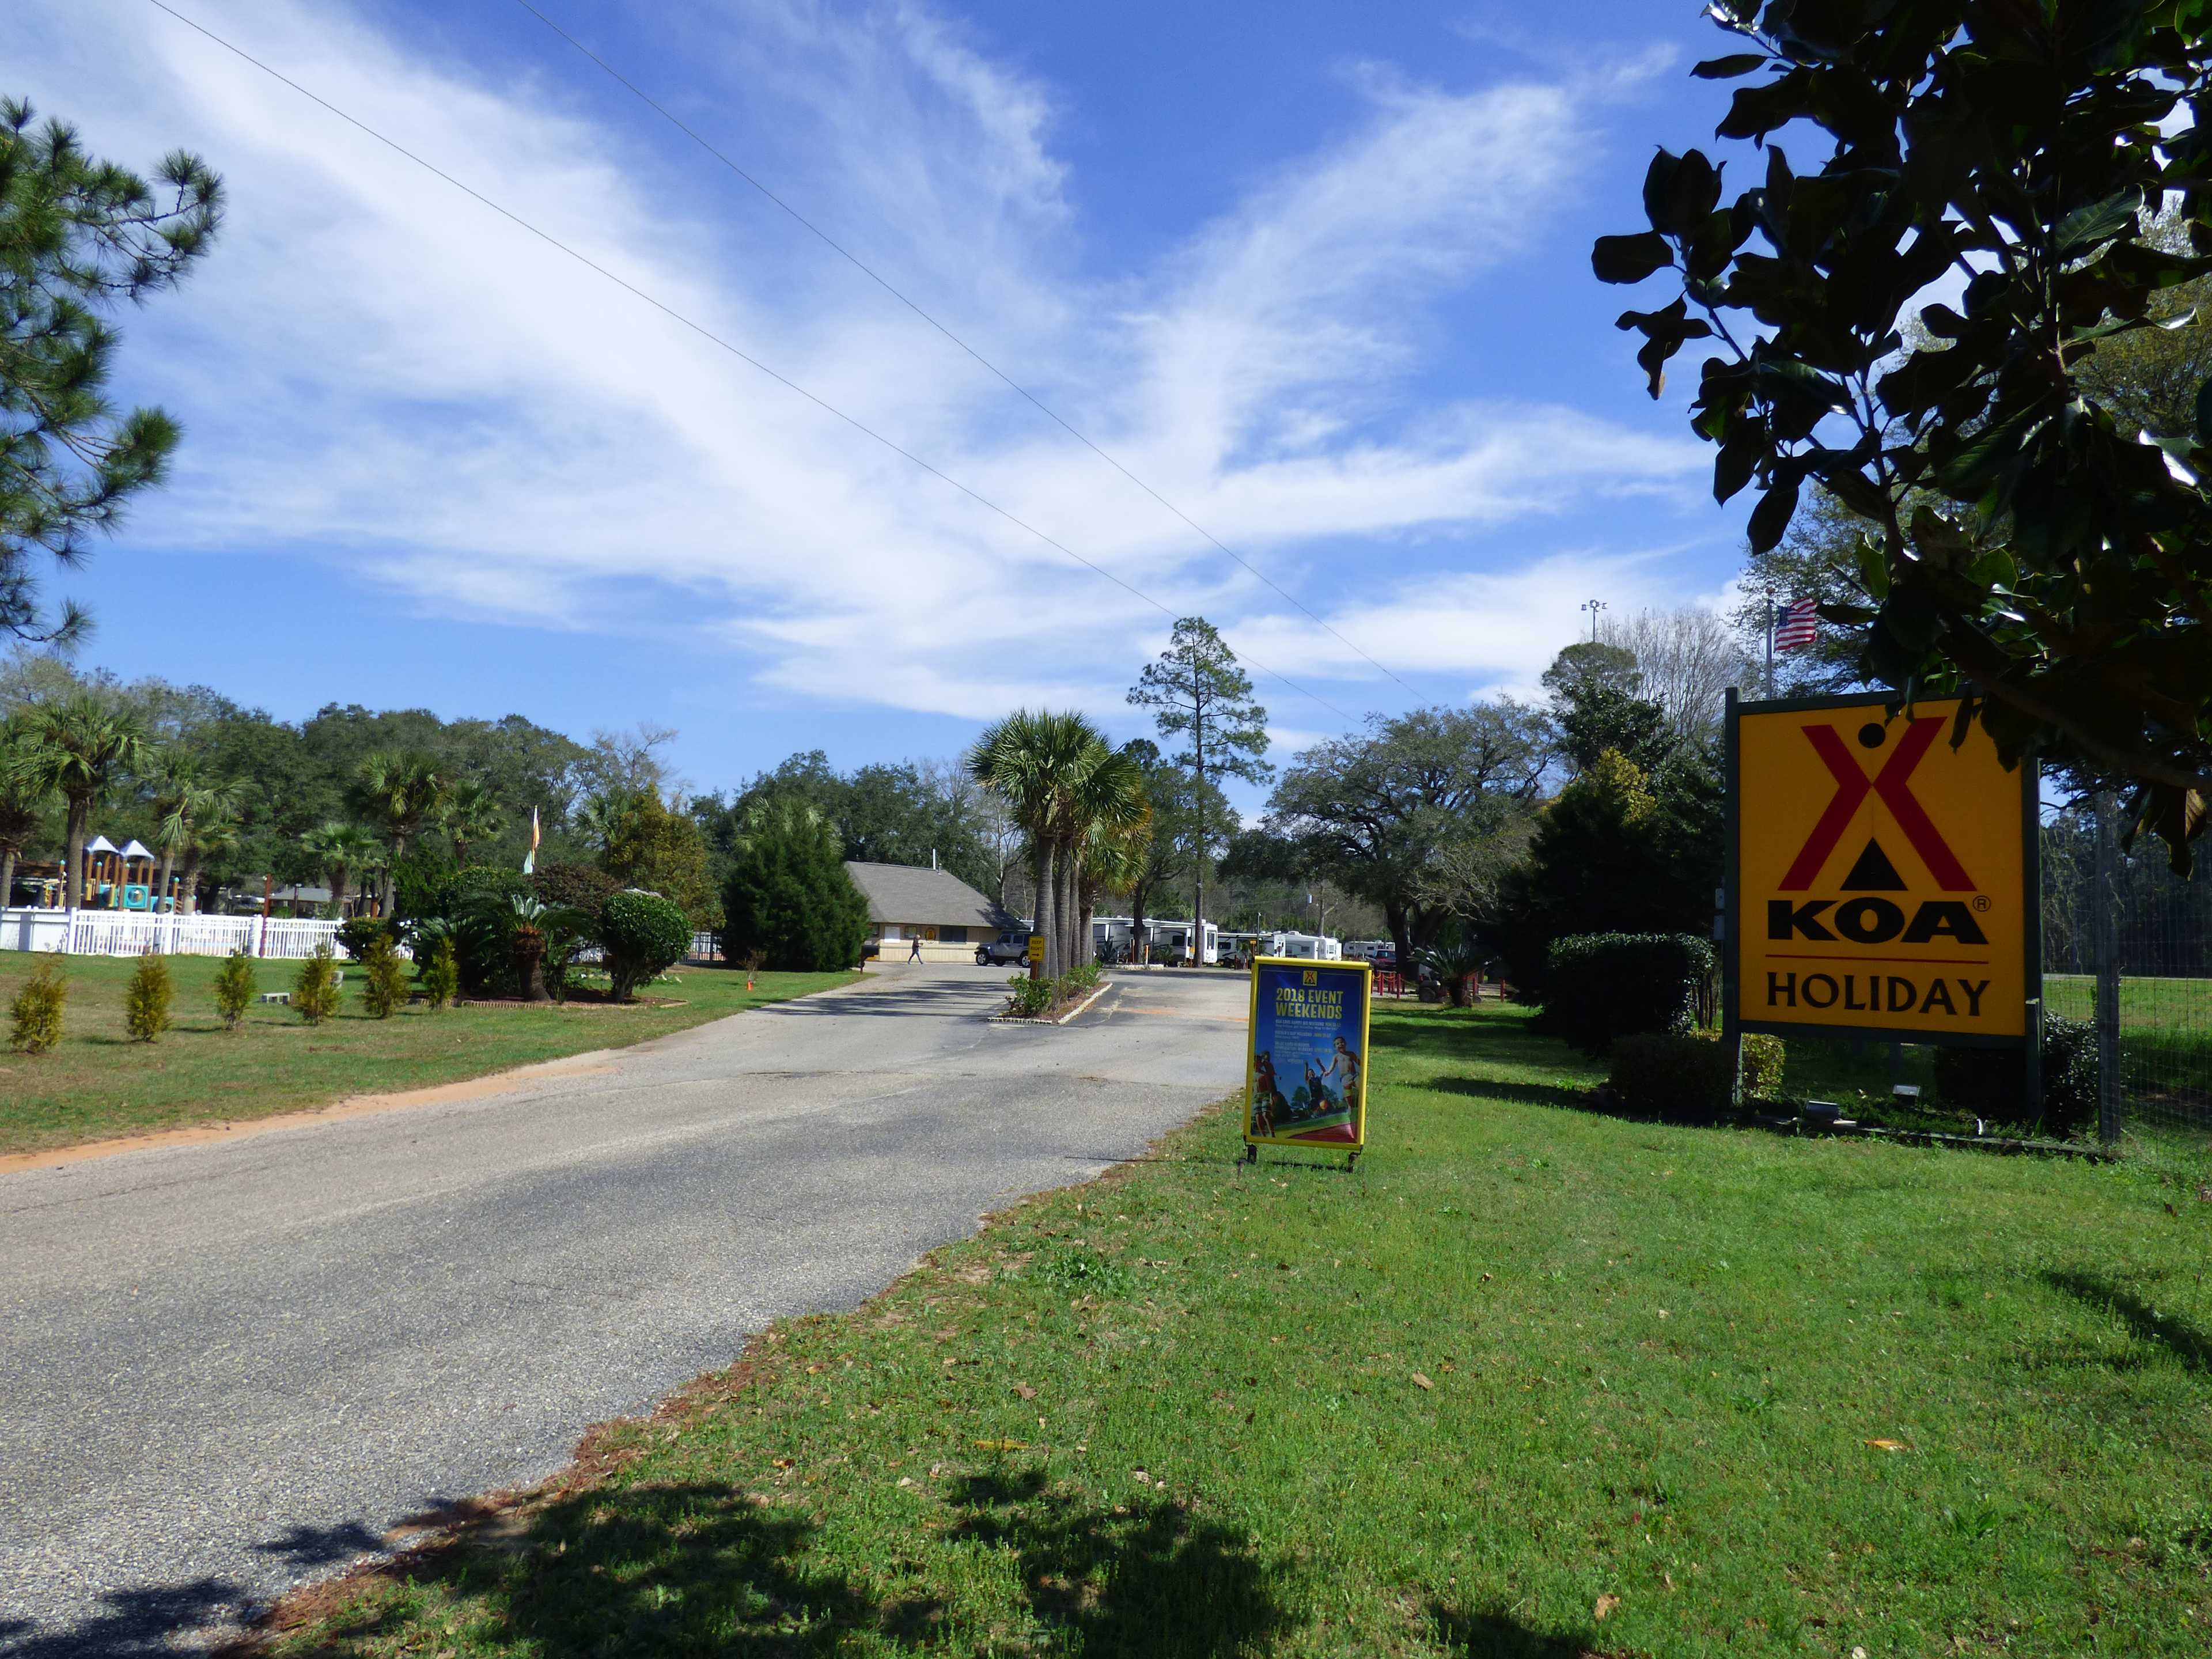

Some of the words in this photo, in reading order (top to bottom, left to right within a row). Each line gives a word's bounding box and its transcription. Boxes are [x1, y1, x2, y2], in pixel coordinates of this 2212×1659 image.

[1767, 896, 1990, 945] KOA
[1276, 987, 1305, 1002] 2018
[1308, 989, 1344, 1004] EVENT
[1767, 972, 1991, 1017] HOLIDAY
[1275, 1002, 1343, 1019] WEEKENDS
